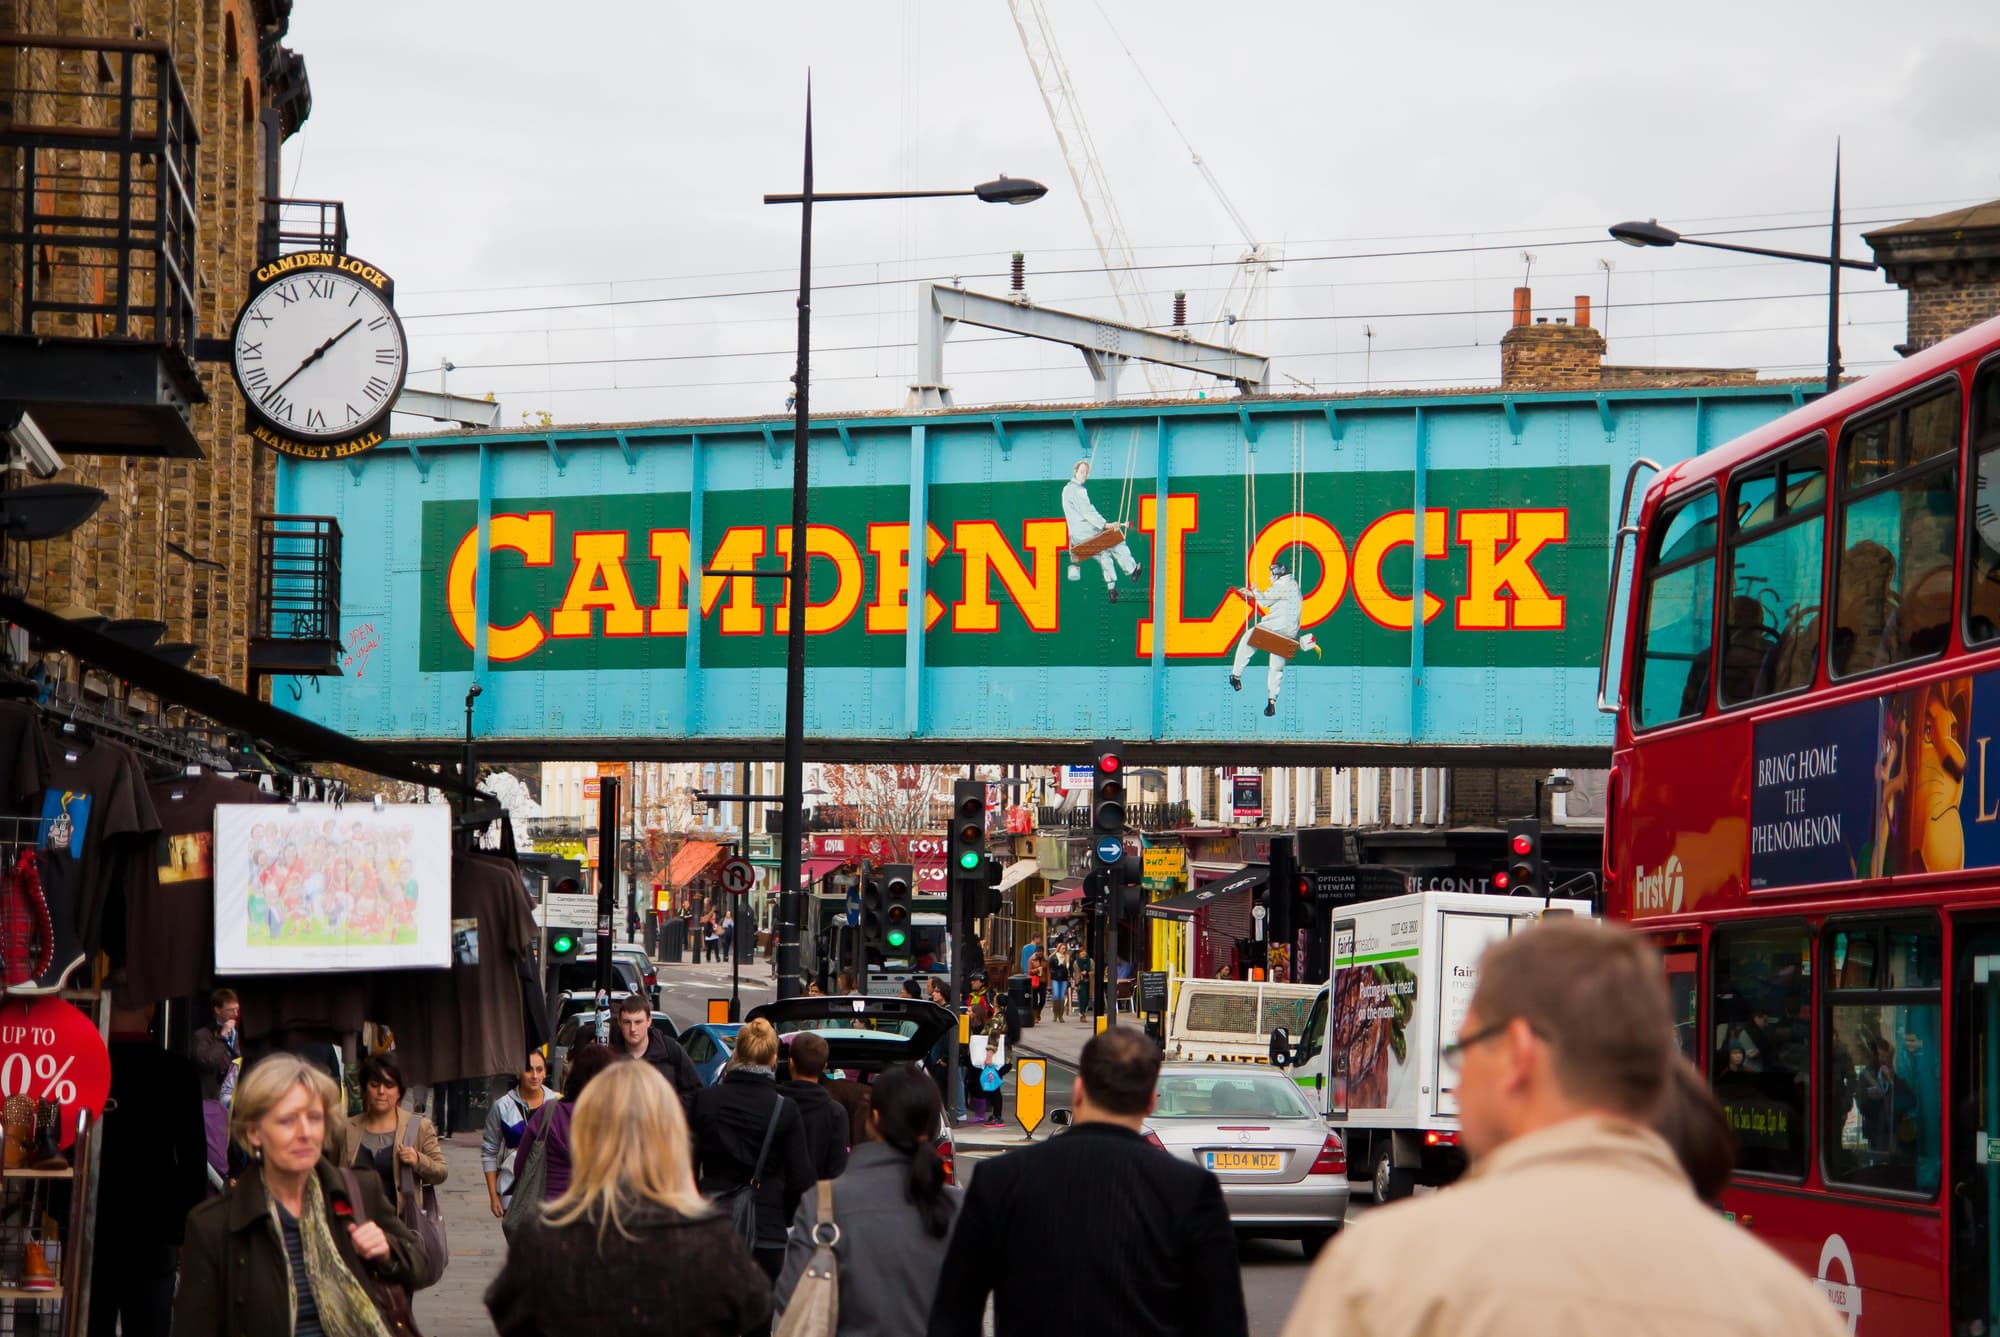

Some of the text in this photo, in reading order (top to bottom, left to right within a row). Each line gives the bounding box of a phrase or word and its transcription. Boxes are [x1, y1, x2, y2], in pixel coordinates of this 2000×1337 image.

[257, 253, 388, 289] CAMDEN LOCK
[253, 425, 382, 458] MARKET HALL
[447, 493, 1568, 662] CAMDEN LOCK
[345, 622, 374, 649] OPEN
[1758, 745, 1838, 787] BRING HOME
[1784, 788, 1806, 815] THE
[1752, 813, 1841, 854] PHENOMENON
[1408, 877, 1423, 893] EYE
[1636, 864, 1664, 909] First
[1360, 980, 1414, 1001] Putting great meat
[1367, 1006, 1377, 1020] the
[1377, 1006, 1395, 1019] menu
[2, 1026, 55, 1046] UP TO
[1216, 1152, 1276, 1166] LL04 WDZ
